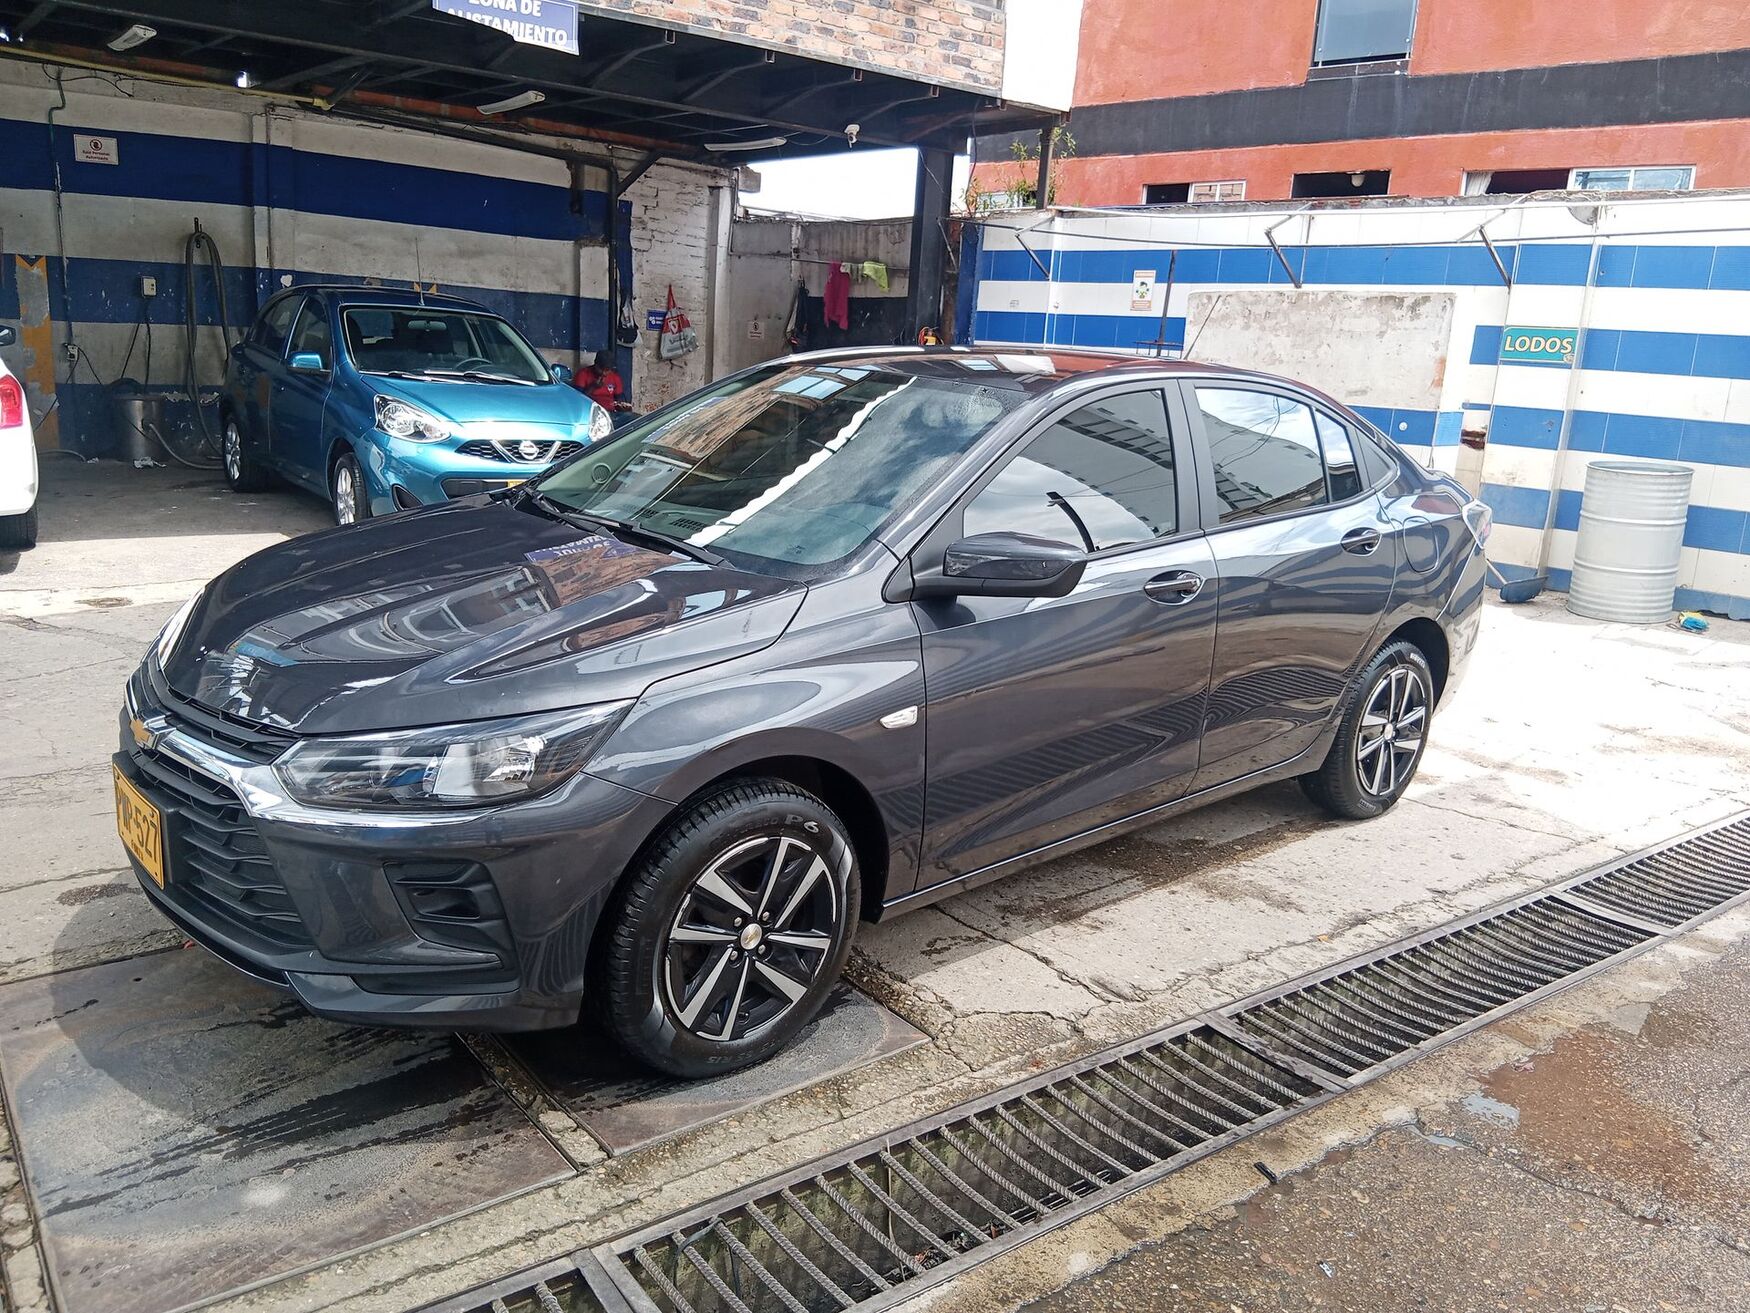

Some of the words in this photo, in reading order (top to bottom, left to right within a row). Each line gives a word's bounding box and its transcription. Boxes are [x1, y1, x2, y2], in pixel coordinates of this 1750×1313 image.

[469, 0, 517, 12] NA
[521, 0, 542, 17] DE
[1504, 335, 1573, 354] LODOS
